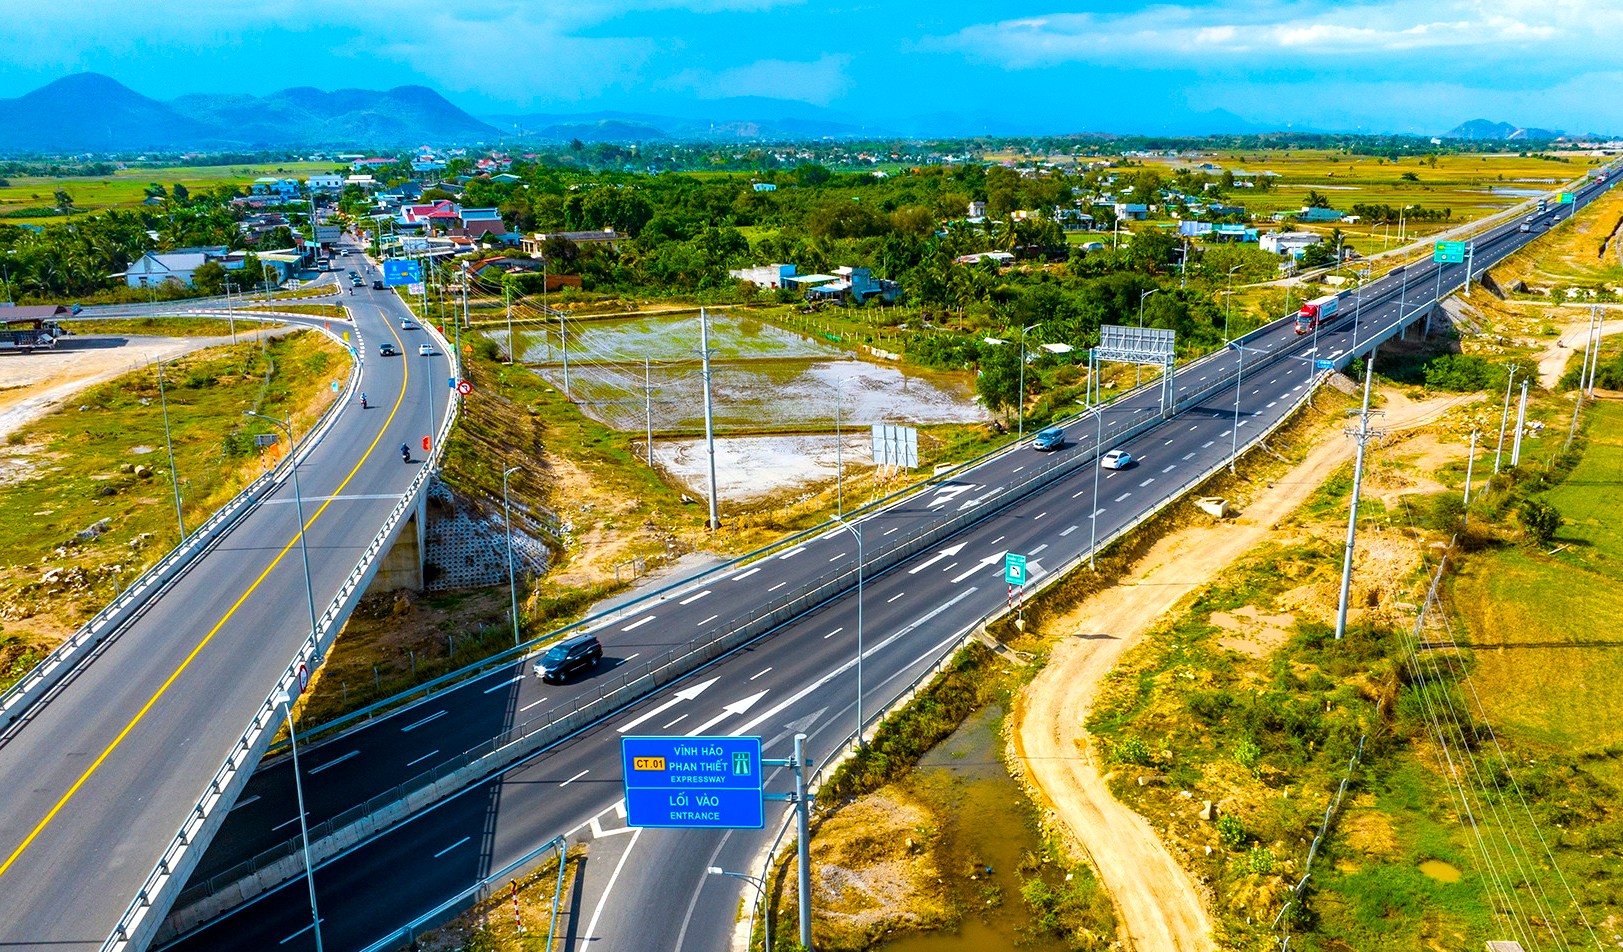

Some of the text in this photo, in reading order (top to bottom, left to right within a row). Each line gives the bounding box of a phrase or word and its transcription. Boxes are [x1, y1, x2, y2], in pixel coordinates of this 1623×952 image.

[673, 743, 724, 756] VĨNH HẢO
[636, 759, 663, 768] CT.01
[669, 758, 729, 772] PHAN THIẾT
[670, 775, 726, 783] EXPRESSWAY
[669, 791, 719, 807] LỐI VÀO
[670, 811, 720, 820] ENTRANCE
